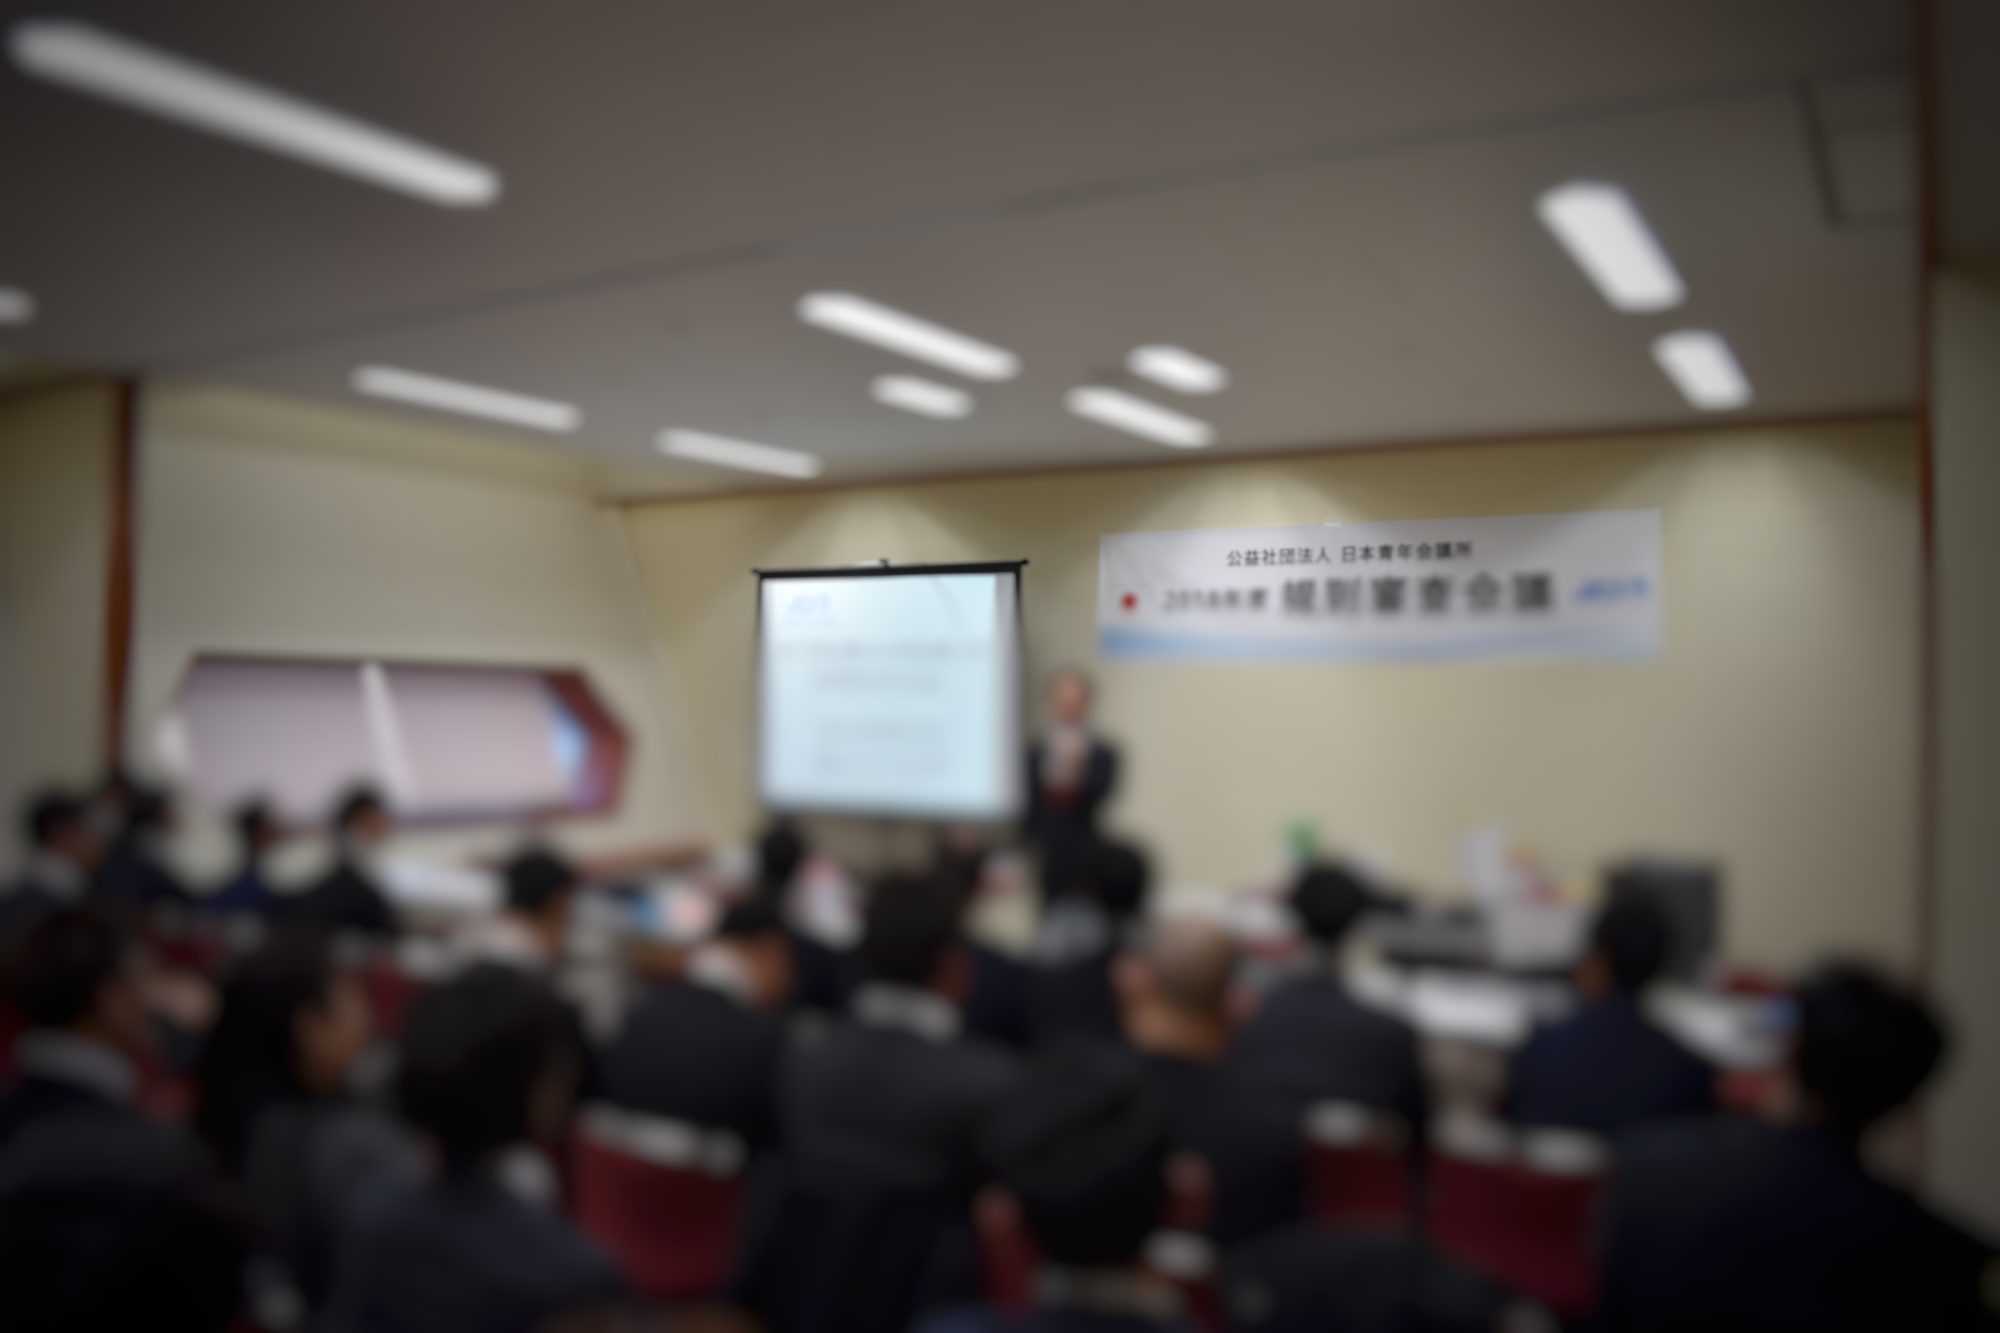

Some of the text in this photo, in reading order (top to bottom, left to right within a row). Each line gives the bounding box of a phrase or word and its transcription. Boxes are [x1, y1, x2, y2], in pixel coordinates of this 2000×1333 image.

[1226, 540, 1473, 567] 公益社団法人 日本青年会議所
